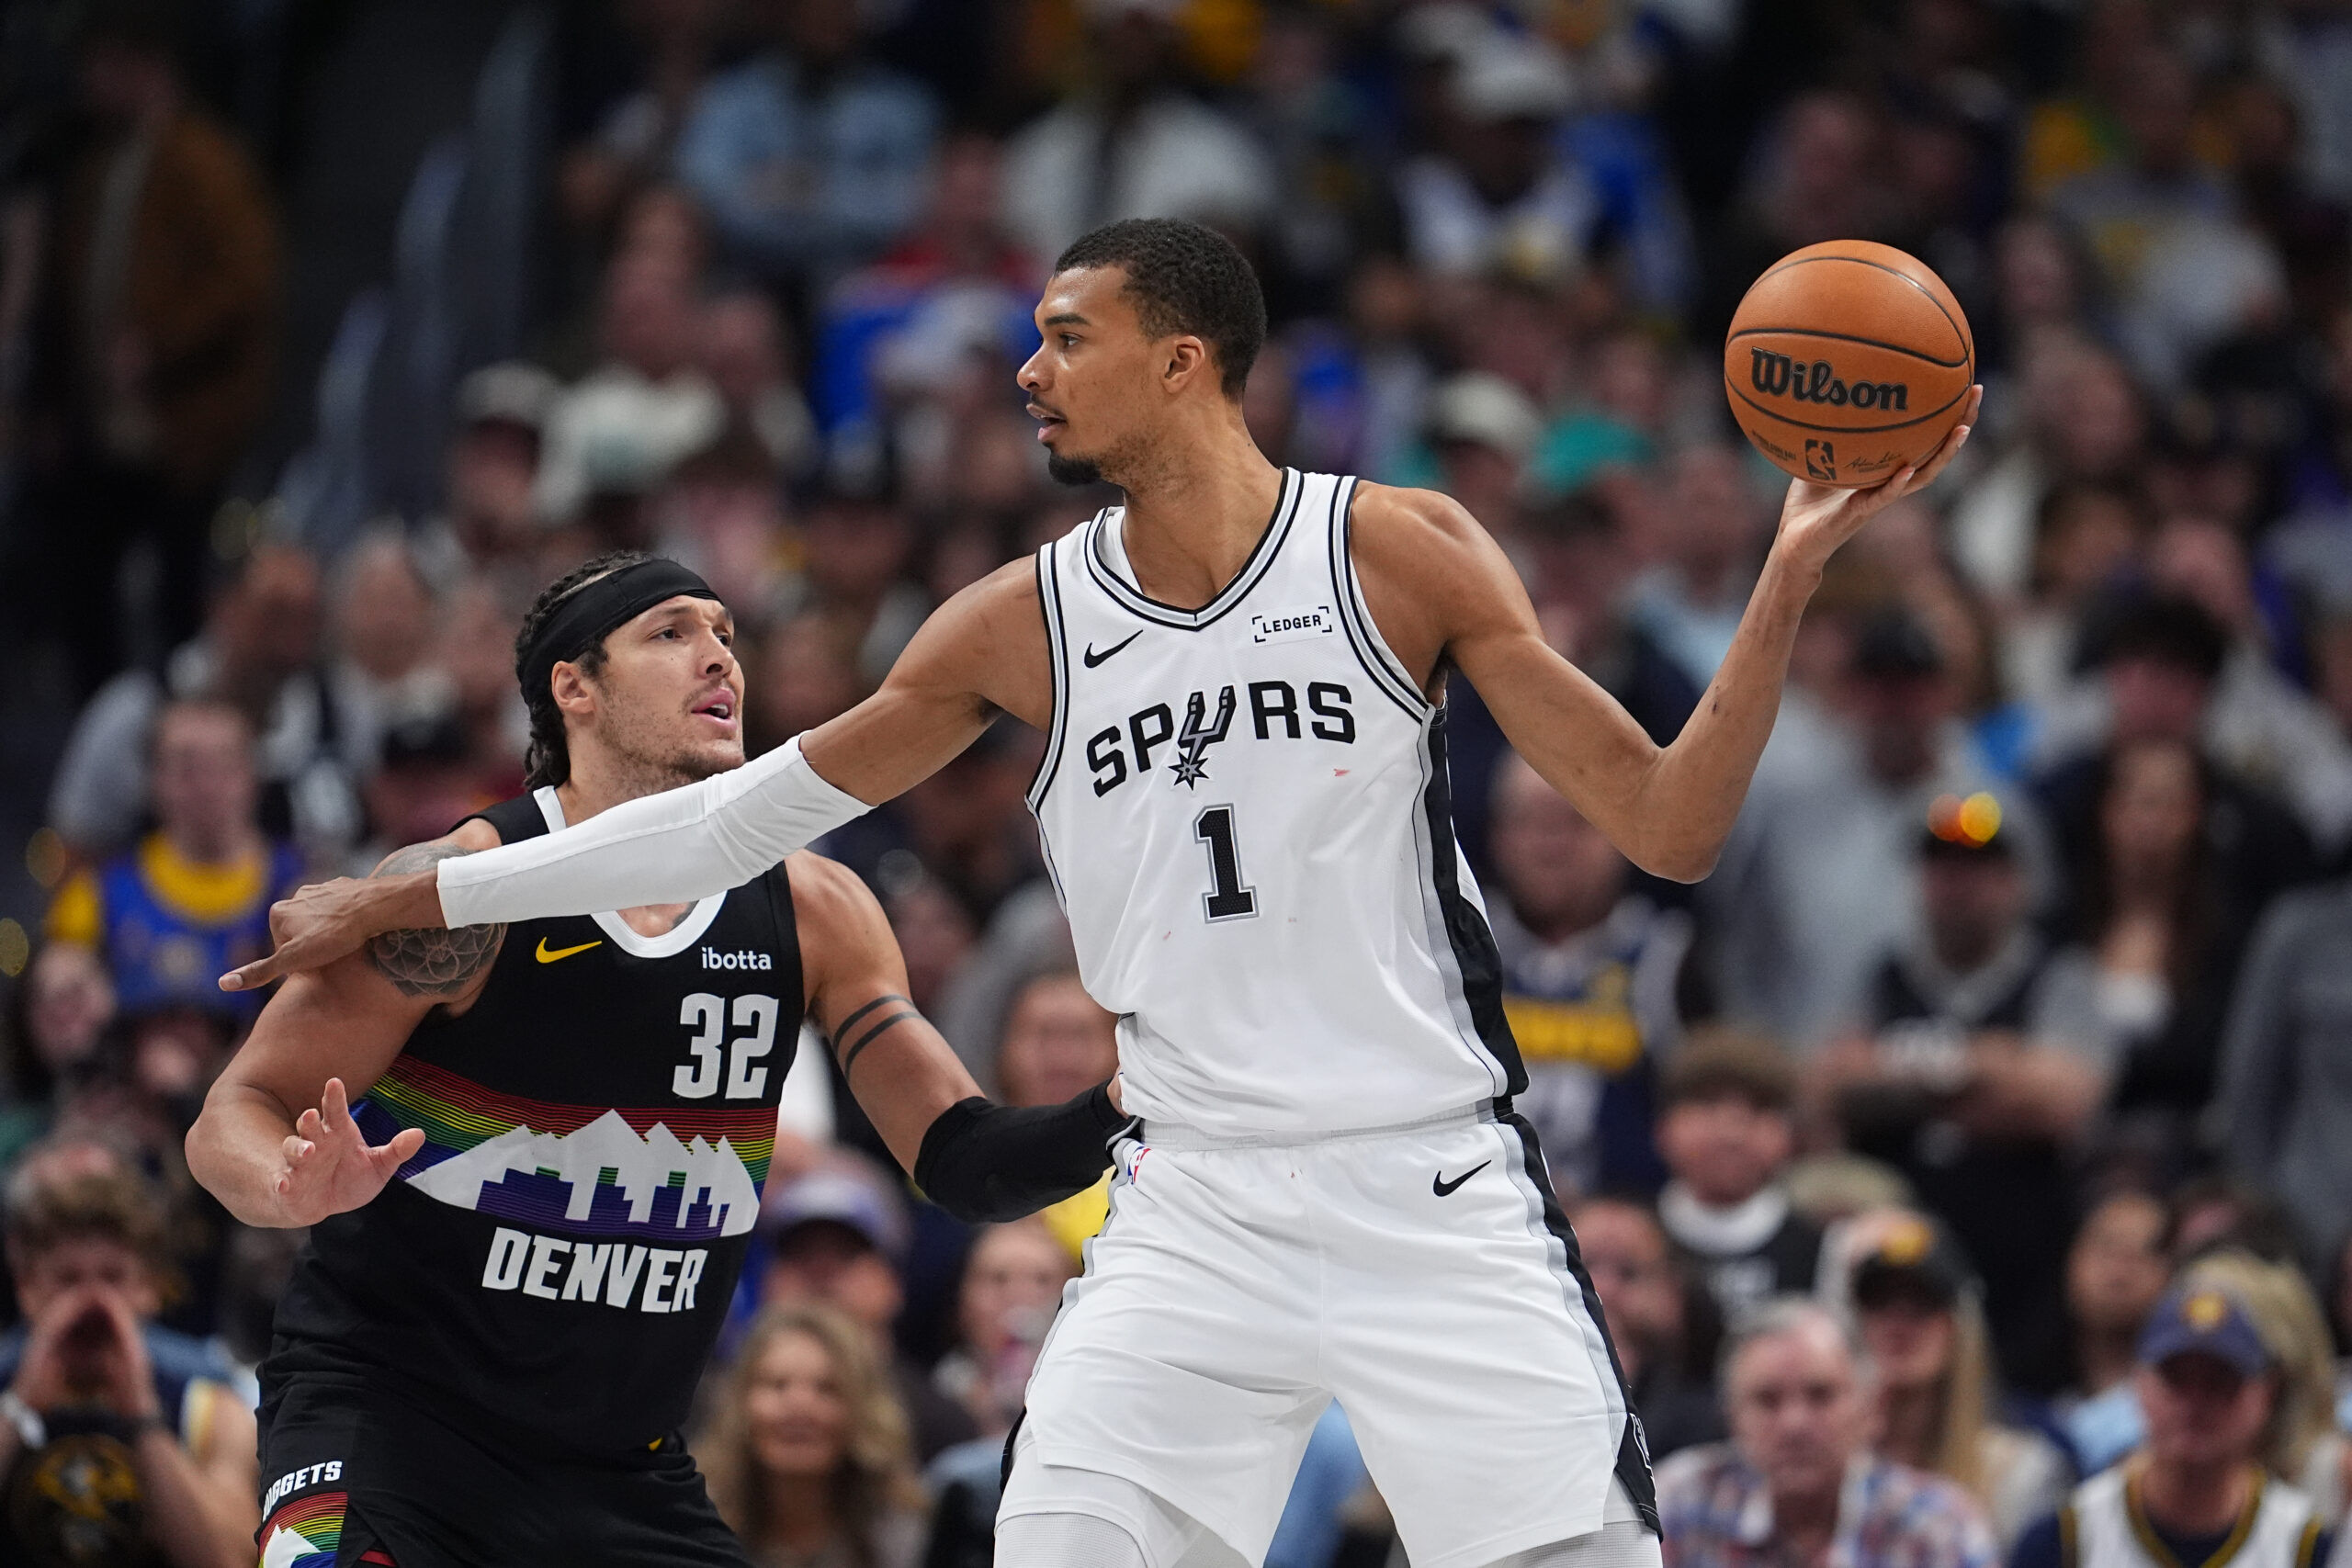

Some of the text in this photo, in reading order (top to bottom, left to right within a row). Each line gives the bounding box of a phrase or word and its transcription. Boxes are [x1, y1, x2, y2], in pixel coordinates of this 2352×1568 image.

[1750, 347, 1908, 411] Wilson
[1262, 615, 1322, 634] LEDGER
[1086, 681, 1356, 798] SPURS
[1193, 802, 1260, 924] 1
[701, 946, 772, 971] ibotta
[672, 992, 779, 1100] 32
[481, 1226, 708, 1314] DENVER
